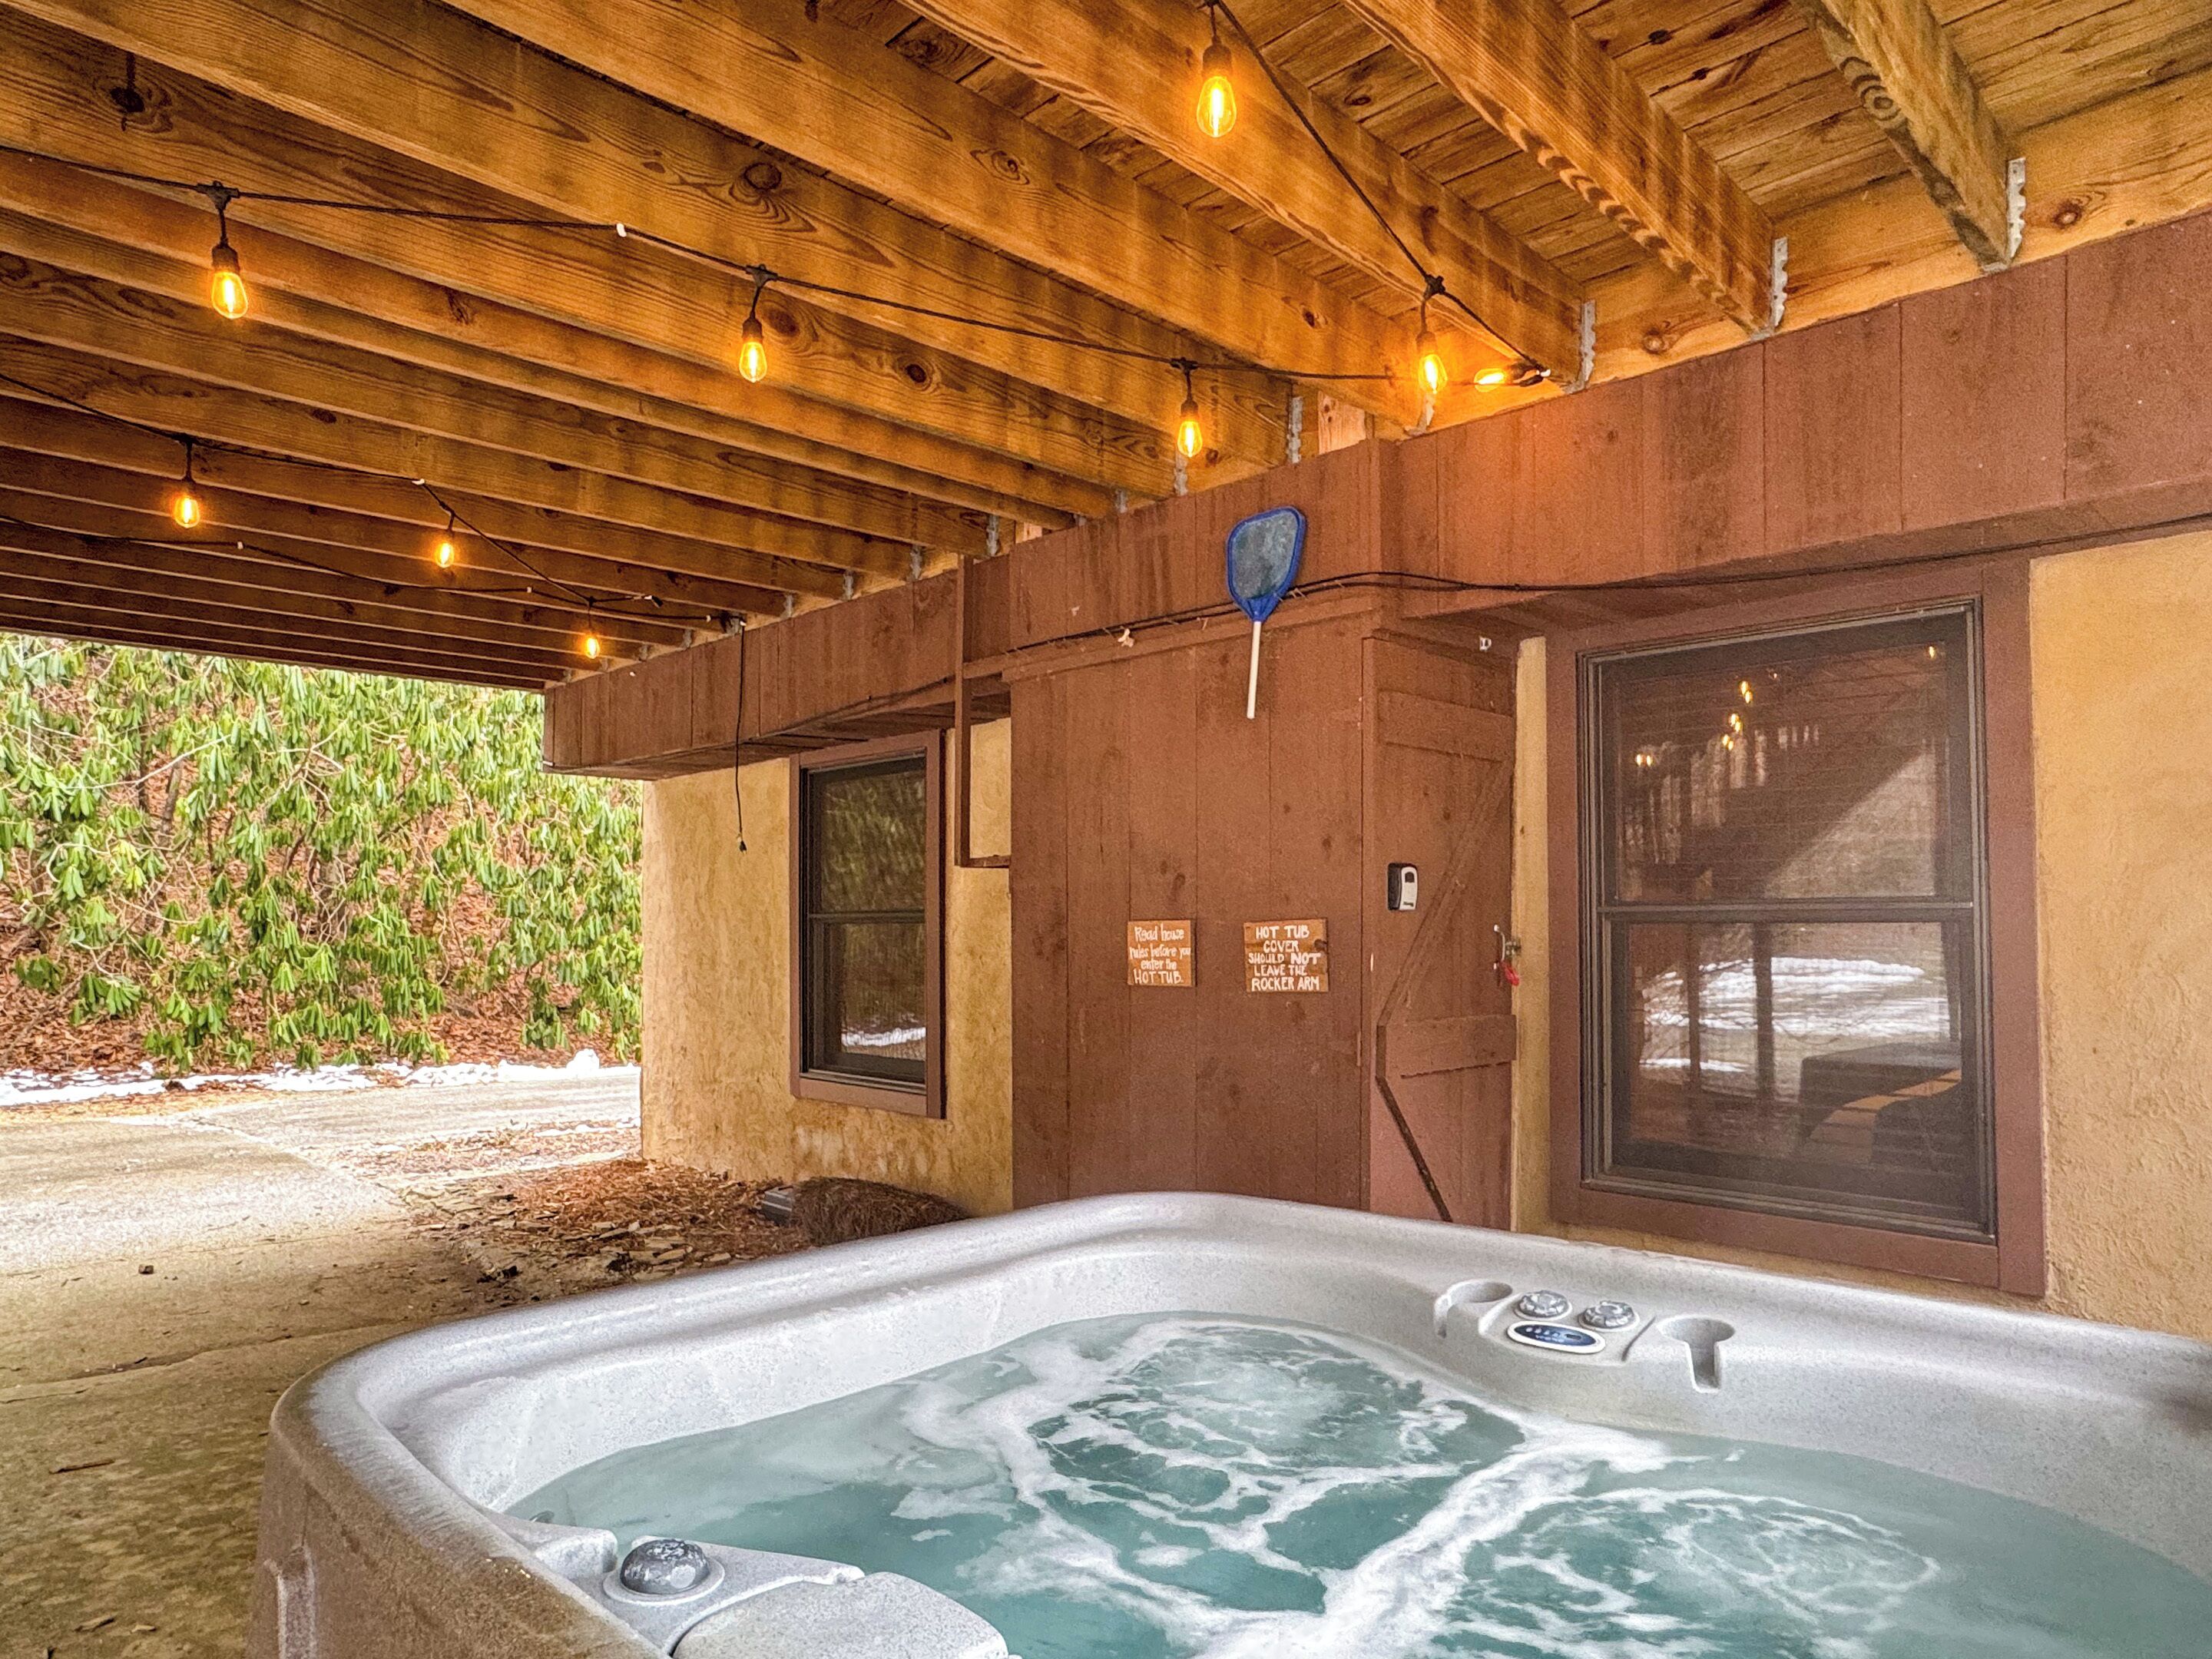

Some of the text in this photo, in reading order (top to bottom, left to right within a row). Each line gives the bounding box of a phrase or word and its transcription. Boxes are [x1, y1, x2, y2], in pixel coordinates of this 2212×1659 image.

[1134, 923, 1184, 942] Read house
[1256, 925, 1310, 939] HOT TUB
[1129, 943, 1191, 959] rules before you
[1263, 940, 1299, 952] COVER
[1141, 958, 1177, 970] enter the
[1248, 952, 1321, 965] SHOULD NOT
[1134, 965, 1157, 984] HOT
[1254, 964, 1307, 976] LEAVE THE
[1252, 976, 1320, 992] ROCKER ARM
